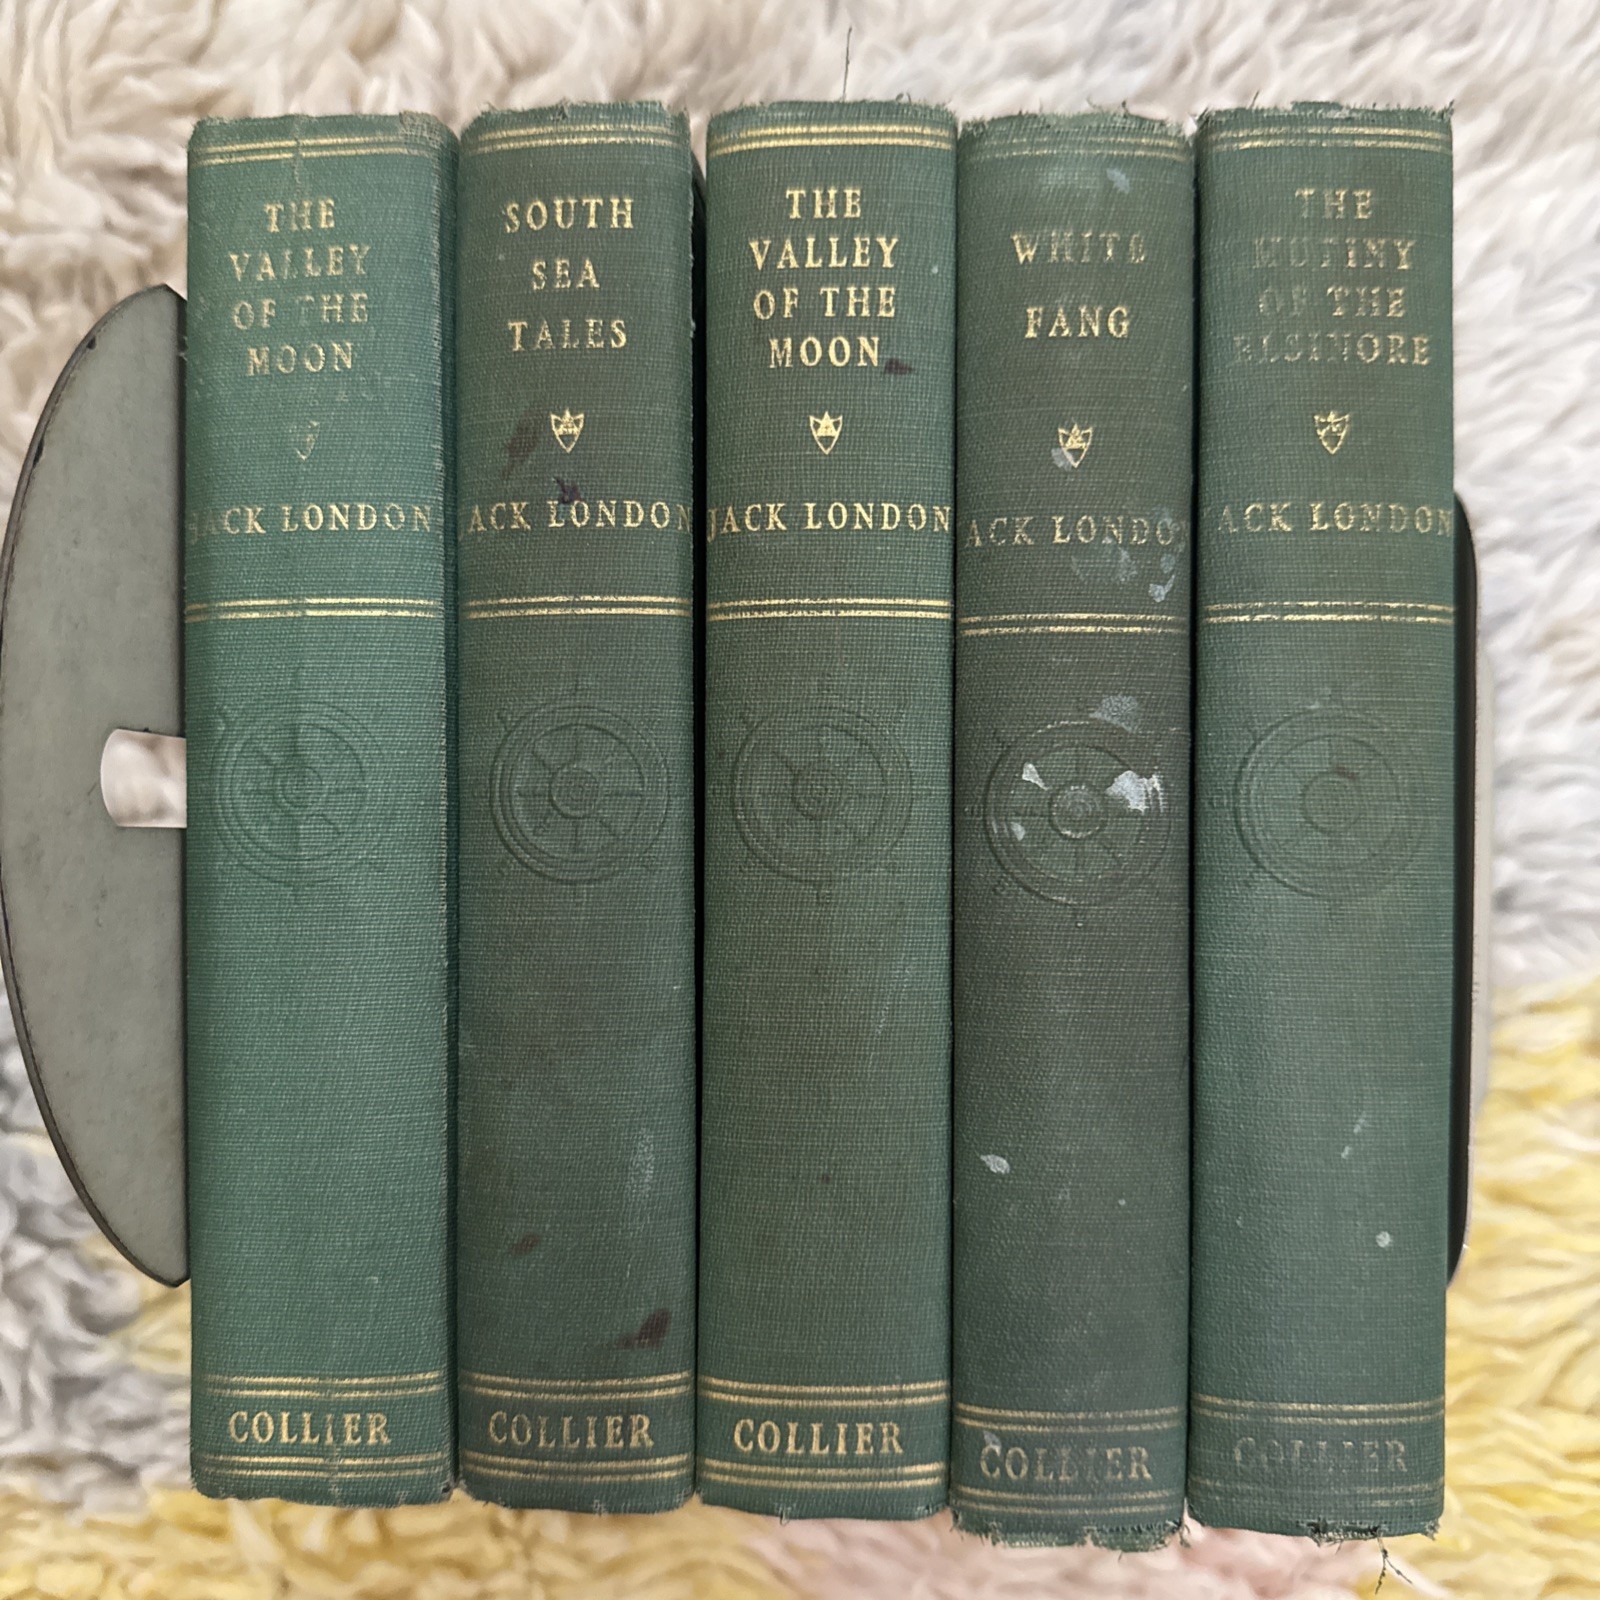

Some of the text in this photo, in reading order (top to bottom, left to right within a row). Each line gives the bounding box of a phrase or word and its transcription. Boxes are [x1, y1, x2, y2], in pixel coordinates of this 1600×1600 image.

[264, 199, 335, 233] THE
[505, 197, 634, 233] SOUTH
[786, 188, 861, 219] THE
[1295, 187, 1373, 220] THE
[228, 244, 371, 281] VALLEY
[750, 236, 898, 271] VALLEY
[532, 259, 600, 290] SEA
[231, 298, 276, 330] OF
[753, 285, 896, 320] OF THE
[1327, 286, 1406, 318] THE
[507, 319, 627, 352] TALES
[1025, 305, 1130, 339] FANG
[247, 342, 353, 376] MOON
[769, 336, 880, 369] MOON
[281, 503, 431, 533] LONDON
[458, 500, 692, 538] ACK LONDON
[707, 502, 951, 543] JACK LONDON
[964, 515, 1187, 547] ACK LONDO
[1203, 502, 1453, 536] ACK LONDON
[228, 1411, 391, 1446] COLLIER
[488, 1410, 654, 1449] COLLIER
[733, 1418, 904, 1456] COLLIER
